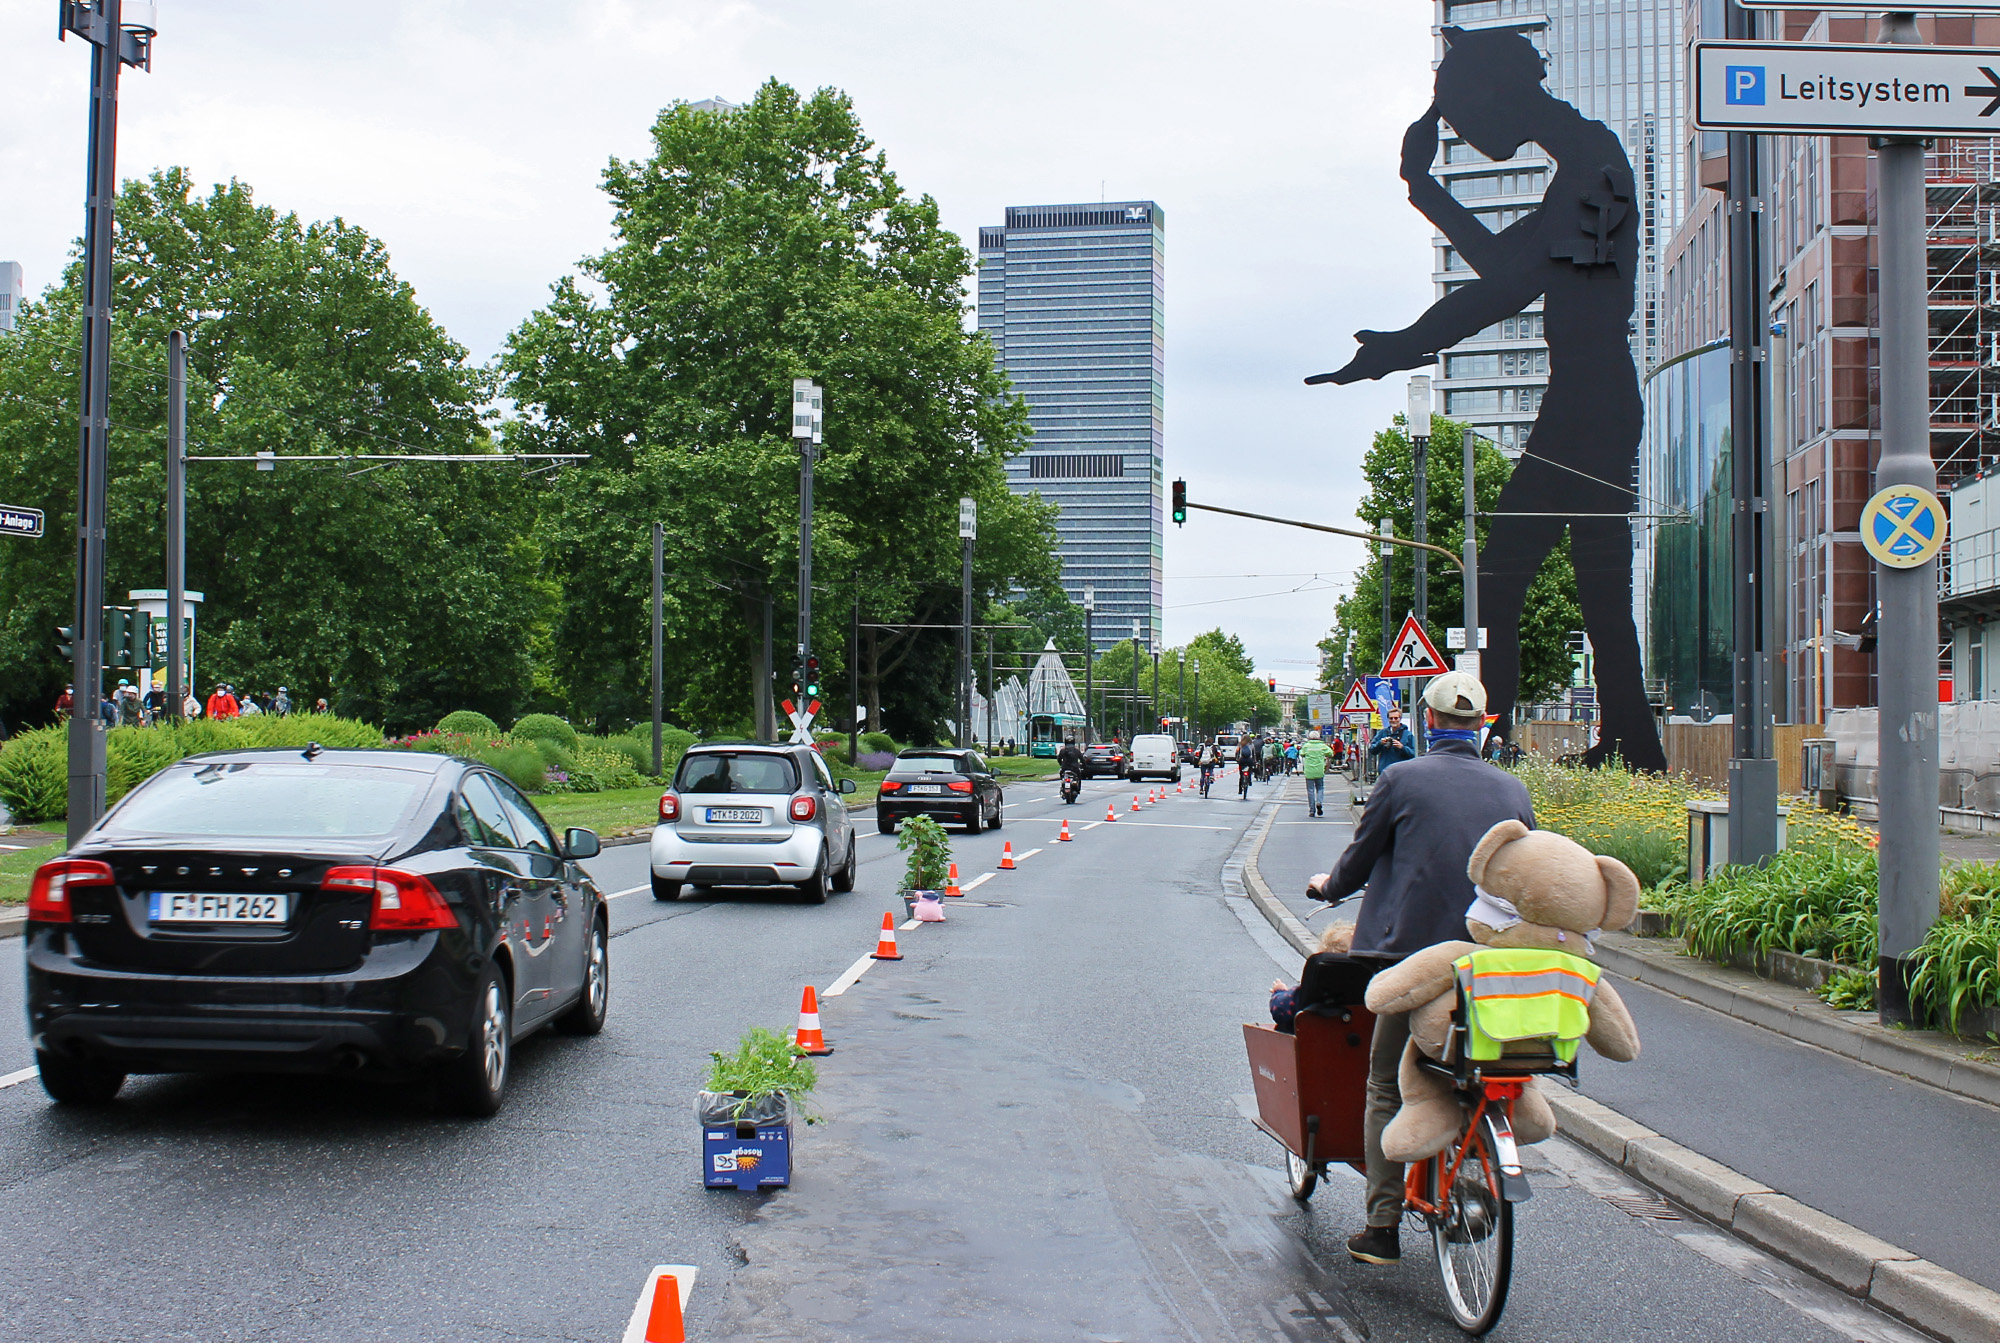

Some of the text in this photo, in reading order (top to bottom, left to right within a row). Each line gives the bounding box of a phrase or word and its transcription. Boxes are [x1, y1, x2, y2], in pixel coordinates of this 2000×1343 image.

[1780, 73, 1950, 108] Leitsystem
[711, 810, 760, 820] MTK B 2022
[141, 865, 292, 877] VOLVO
[171, 896, 276, 919] F FH 262
